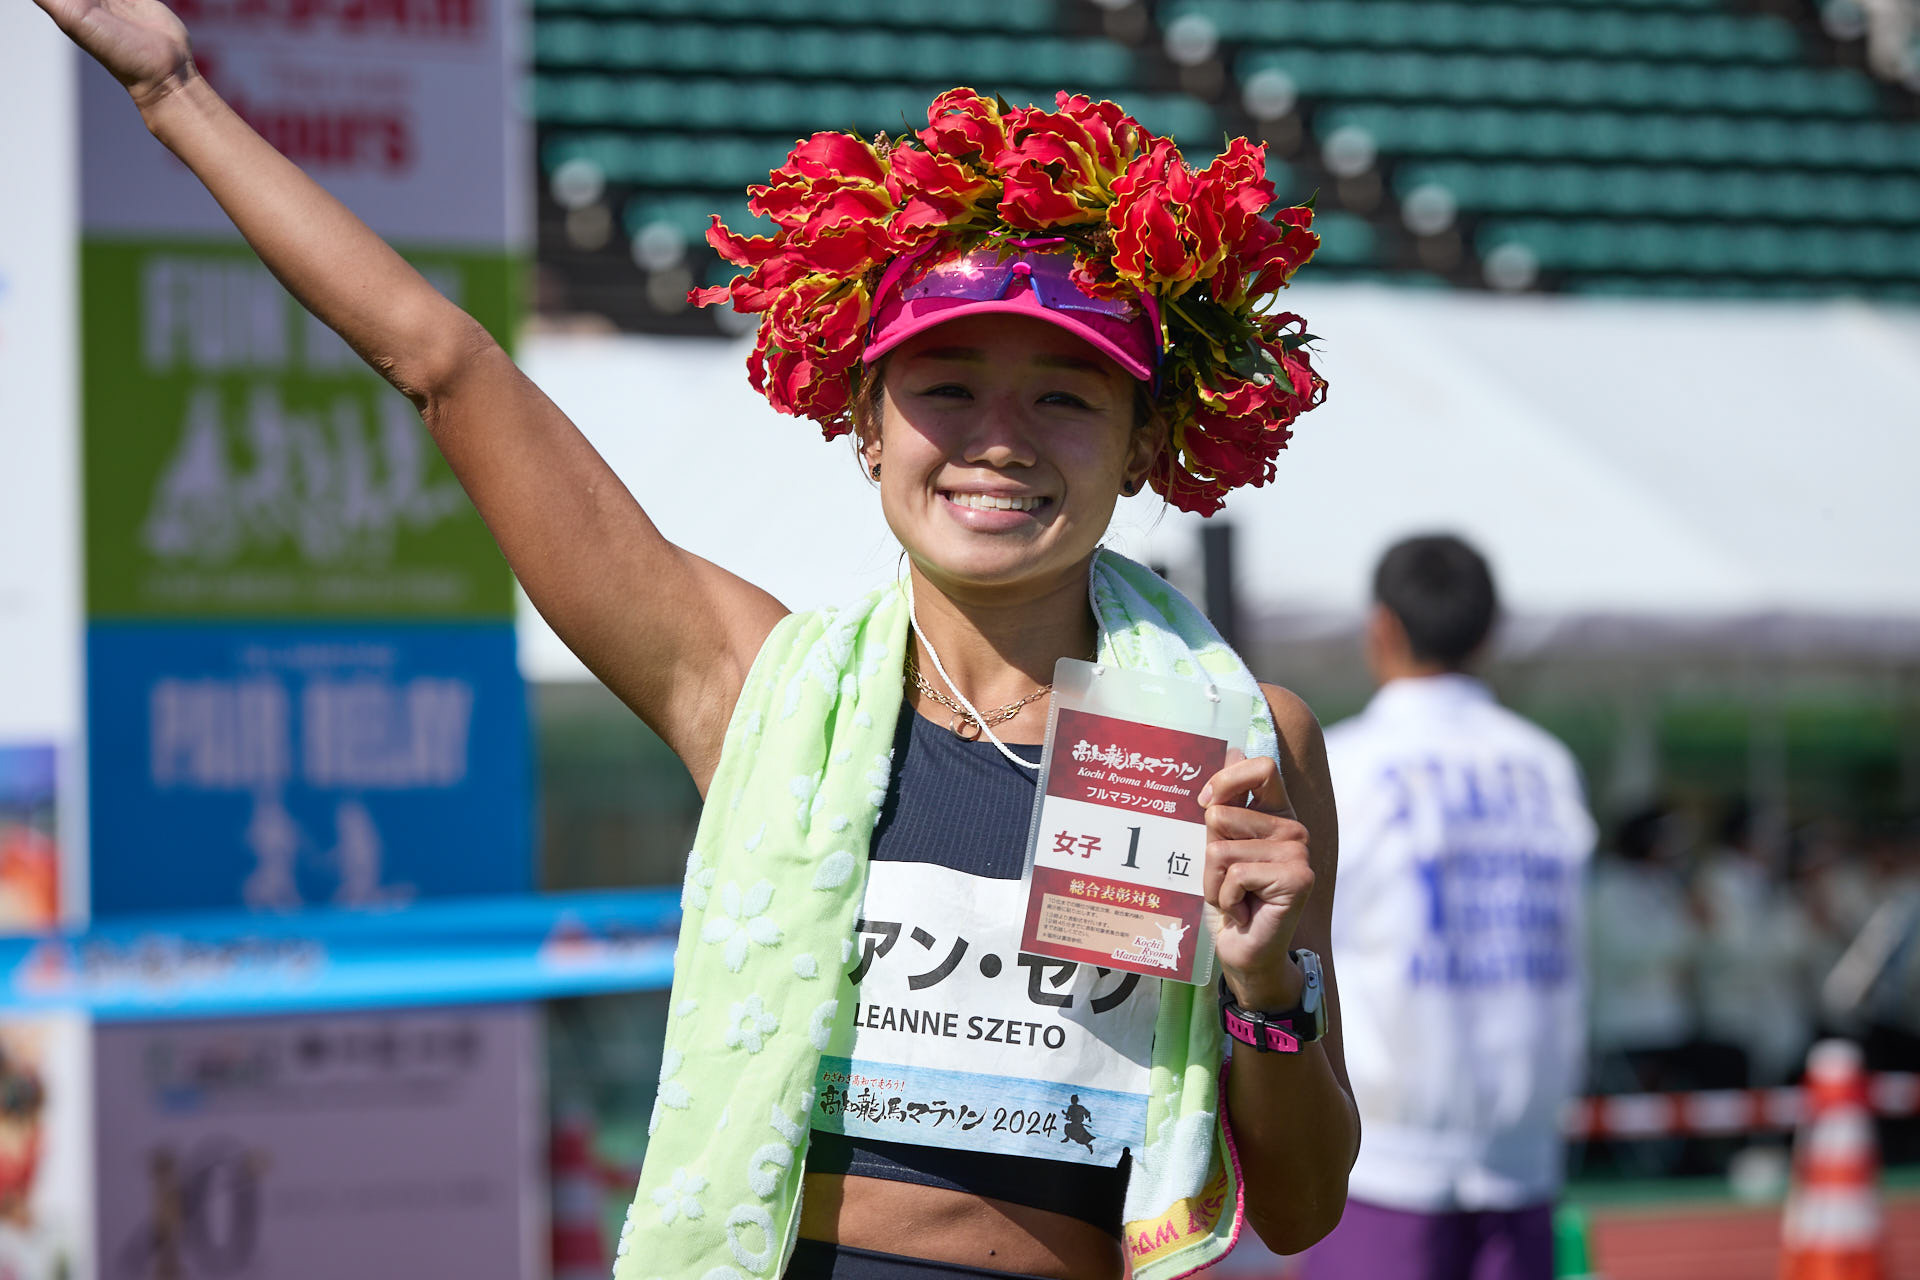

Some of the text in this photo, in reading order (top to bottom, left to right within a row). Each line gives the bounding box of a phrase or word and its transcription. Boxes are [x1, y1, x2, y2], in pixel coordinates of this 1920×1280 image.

[1072, 739, 1201, 781] 高知龍馬マラソン
[1077, 767, 1191, 796] Kochi Ryoma Marathon
[1086, 786, 1177, 814] フルマラソンの部
[1052, 826, 1191, 877] 女子 1 位
[1069, 878, 1161, 909] 総合表彰対象
[1113, 950, 1160, 966] Marathon
[1134, 937, 1162, 950] Kochi
[1142, 947, 1174, 961] Ryoma
[852, 1002, 1067, 1050] LEANNE SZETO
[819, 1084, 1058, 1138] 高知龍馬マラソン 2024
